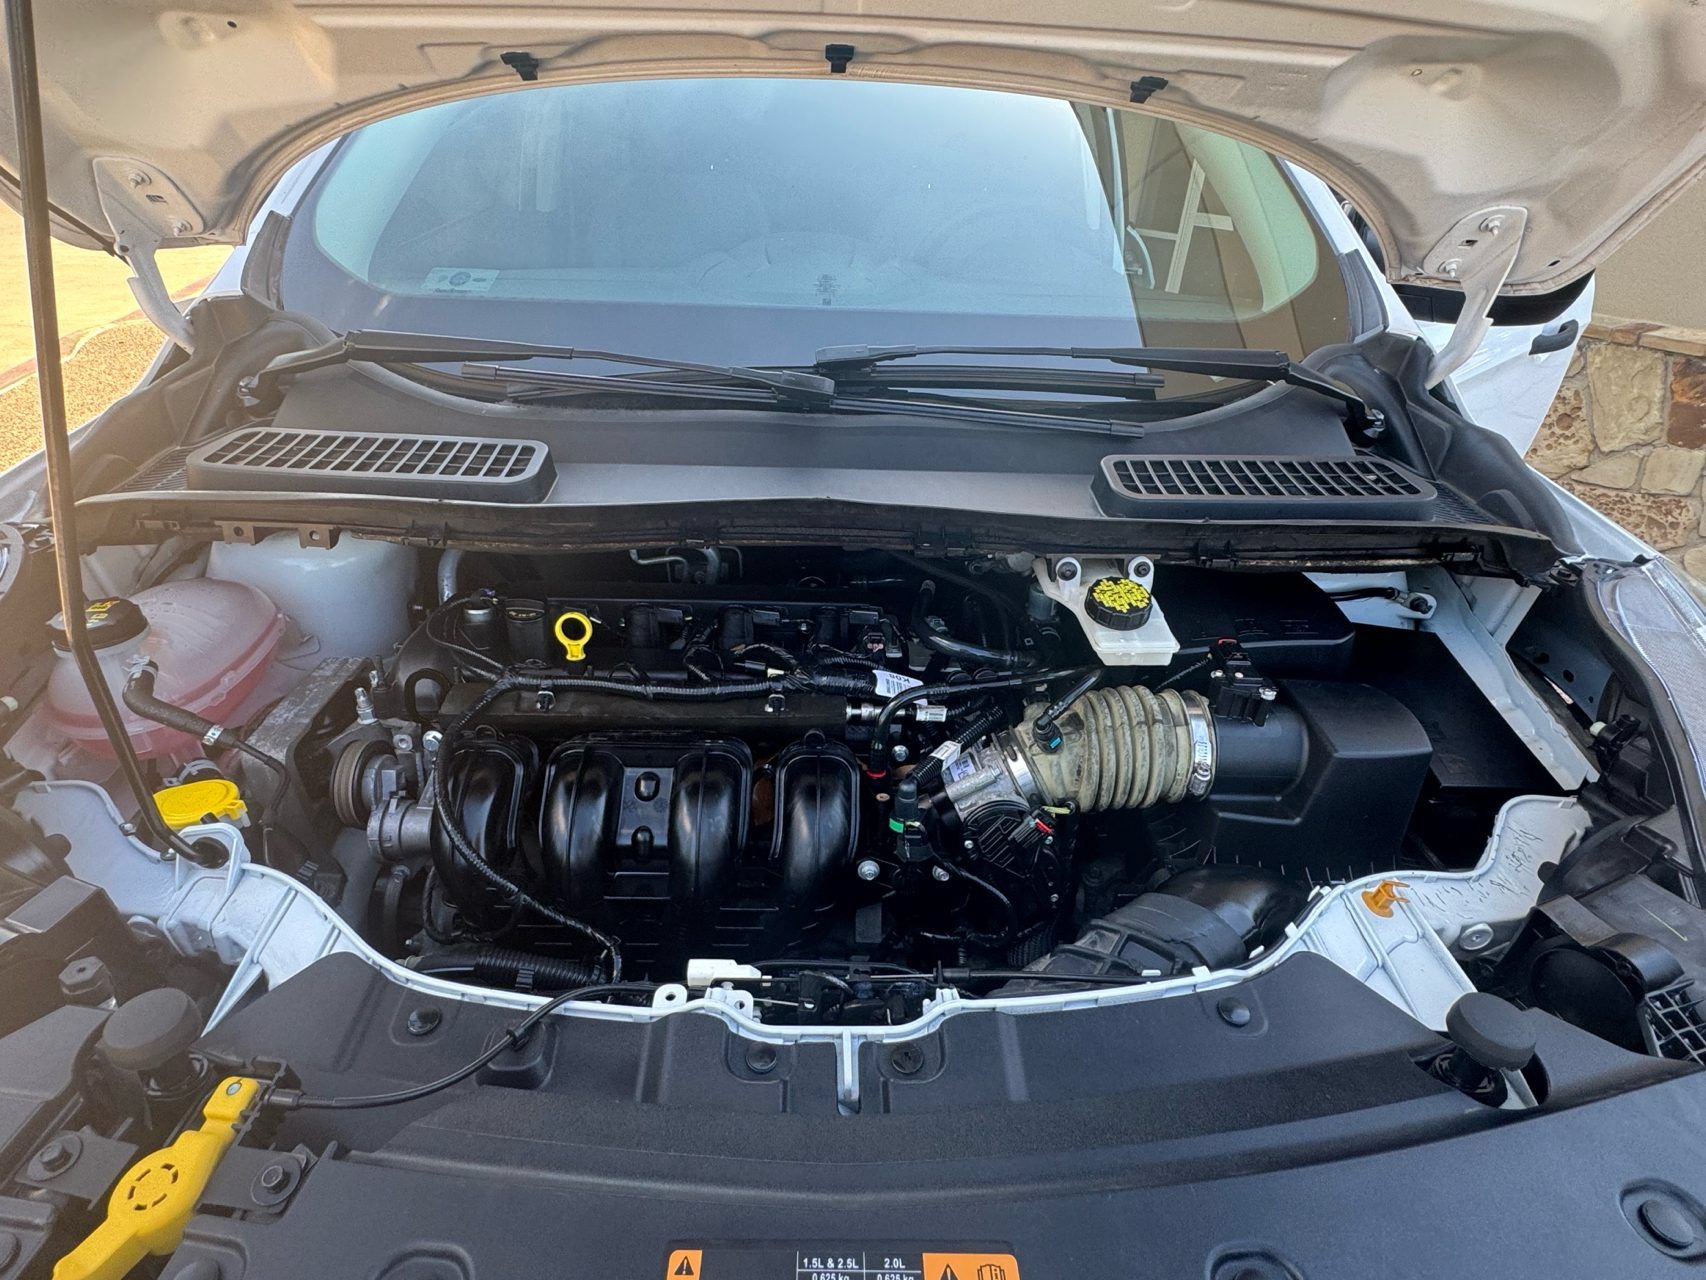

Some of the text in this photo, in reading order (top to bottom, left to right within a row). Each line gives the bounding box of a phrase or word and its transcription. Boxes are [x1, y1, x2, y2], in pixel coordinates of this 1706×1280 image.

[803, 1257, 859, 1269] 1.5L & 2.5L
[884, 1257, 906, 1269] 2.0L
[812, 1272, 836, 1280] 0625
